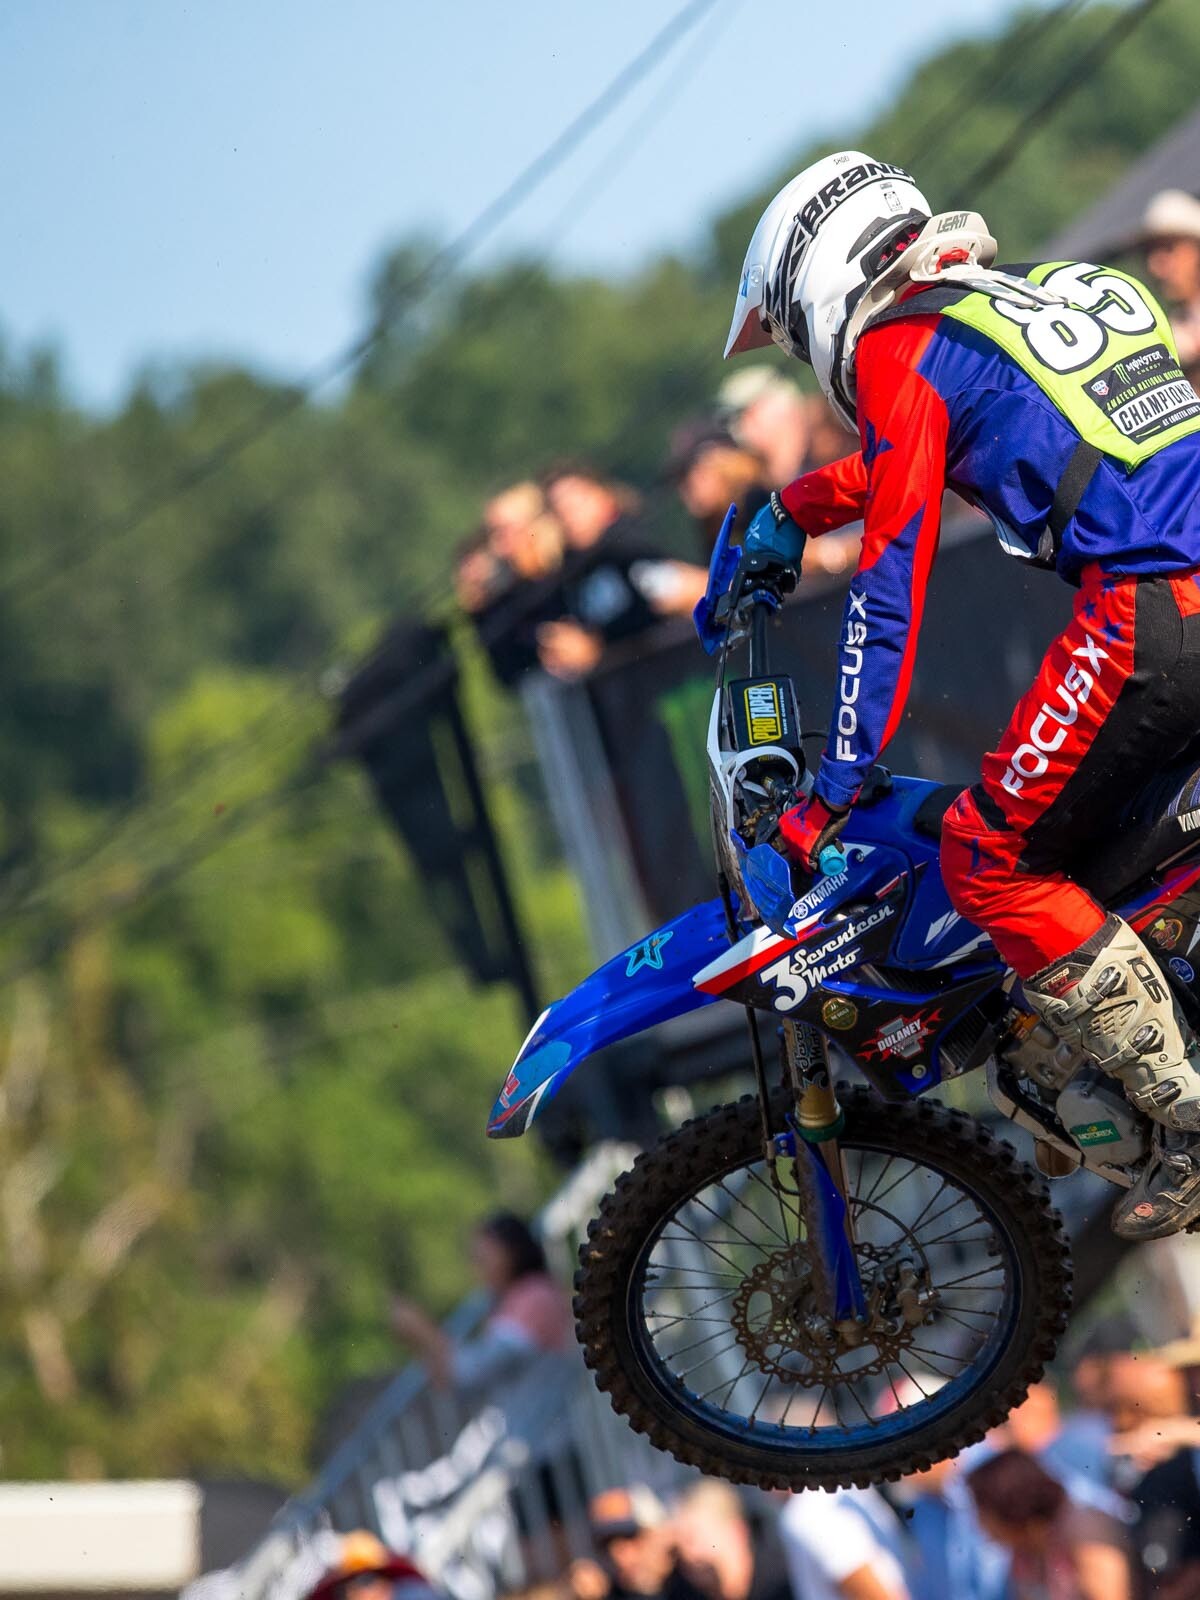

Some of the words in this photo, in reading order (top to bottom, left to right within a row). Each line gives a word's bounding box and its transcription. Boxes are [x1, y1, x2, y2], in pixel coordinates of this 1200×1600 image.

[936, 213, 970, 234] LEATT
[989, 261, 1158, 375] 85
[1125, 350, 1164, 373] MONSTER
[1106, 386, 1138, 411] AMATEUR
[1118, 383, 1197, 432] CHAMPIONS
[805, 871, 849, 909] YAMAHA
[760, 955, 808, 1012] 3
[790, 905, 895, 974] Seventeen
[801, 947, 861, 988] Moto
[877, 1018, 921, 1052] DULANEY
